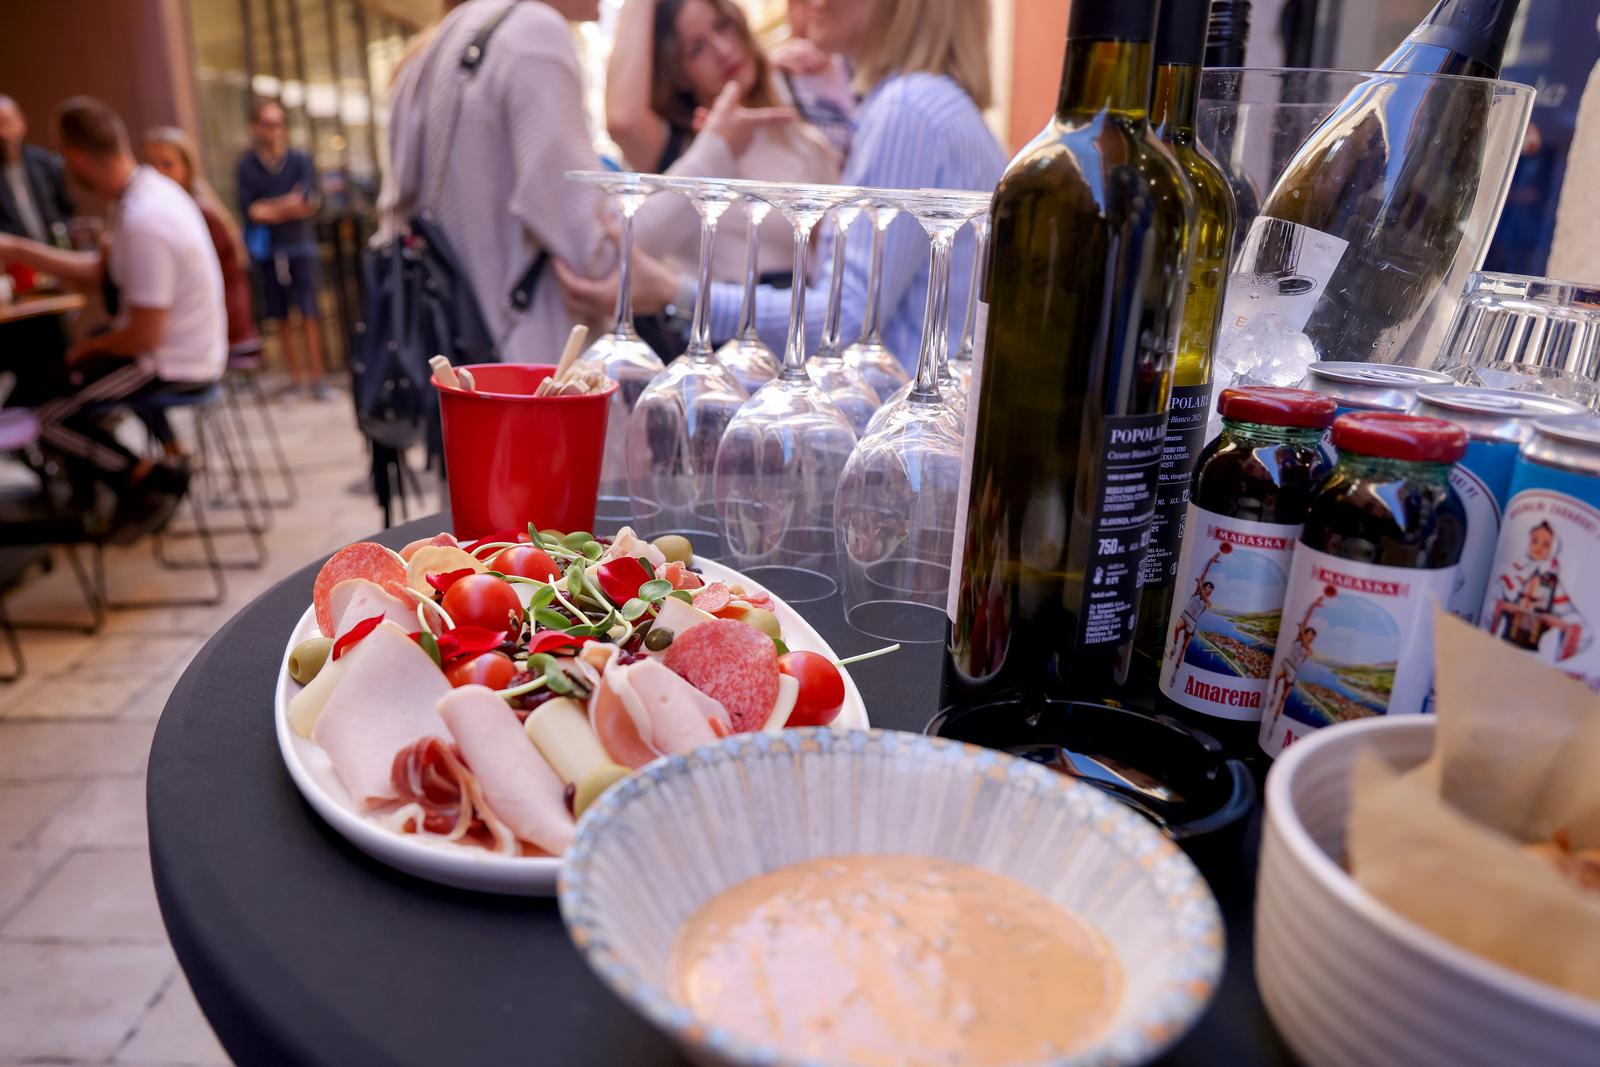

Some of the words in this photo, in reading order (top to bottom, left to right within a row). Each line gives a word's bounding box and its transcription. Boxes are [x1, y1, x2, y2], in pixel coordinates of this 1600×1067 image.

[1169, 394, 1210, 409] POLARE
[1098, 538, 1118, 555] 750
[1217, 530, 1283, 549] MARASKA
[1323, 571, 1395, 595] MARASKA
[1184, 675, 1262, 708] Amarena
